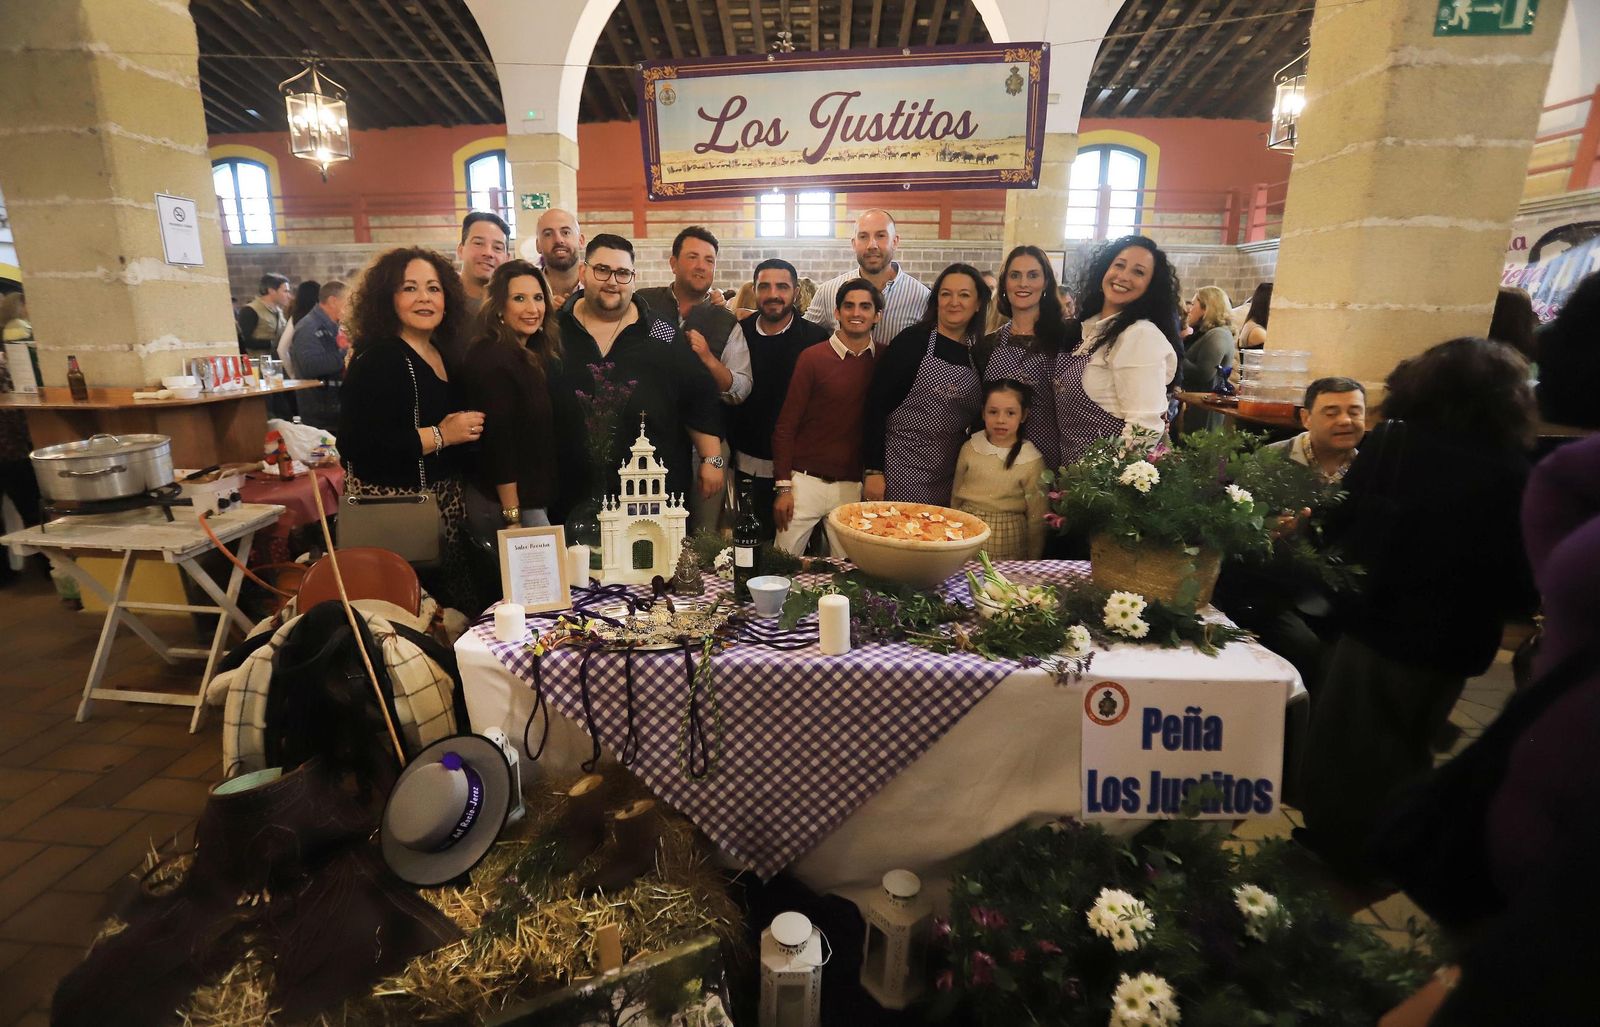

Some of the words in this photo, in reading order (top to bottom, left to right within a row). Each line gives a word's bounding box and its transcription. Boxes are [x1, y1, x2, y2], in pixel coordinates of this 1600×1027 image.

[693, 94, 789, 154] Los
[802, 90, 979, 165] Justitos
[1141, 706, 1223, 752] Peña
[1087, 769, 1141, 814] Los
